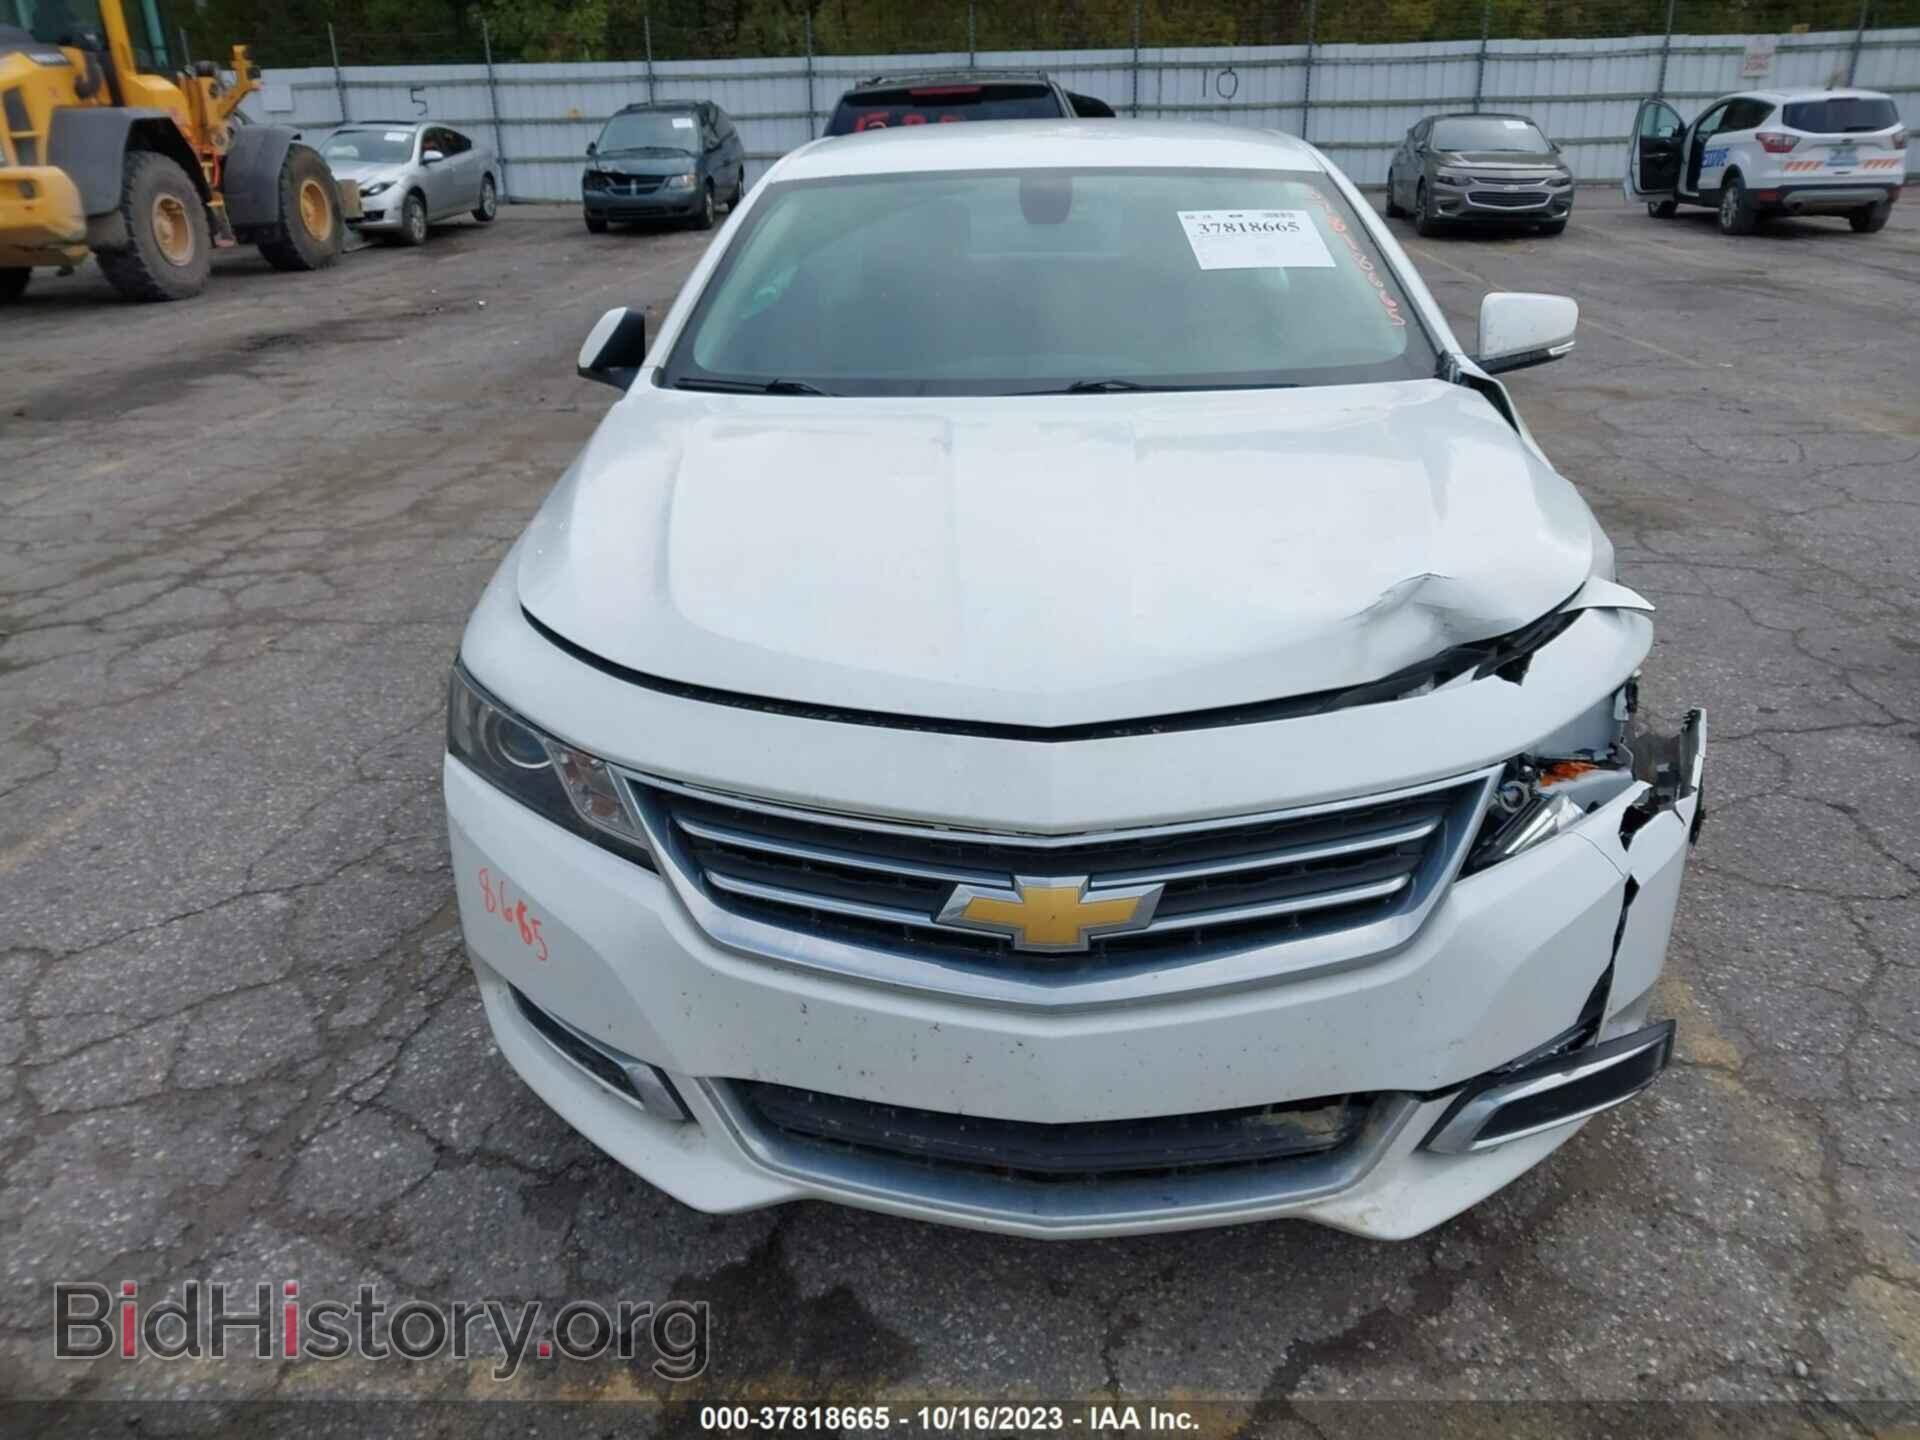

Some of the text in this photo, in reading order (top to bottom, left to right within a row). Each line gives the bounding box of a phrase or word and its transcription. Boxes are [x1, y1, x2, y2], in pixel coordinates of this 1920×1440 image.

[1202, 67, 1239, 99] 10
[410, 86, 428, 117] 5
[1198, 221, 1301, 235] 37818665
[479, 867, 549, 961] 8665
